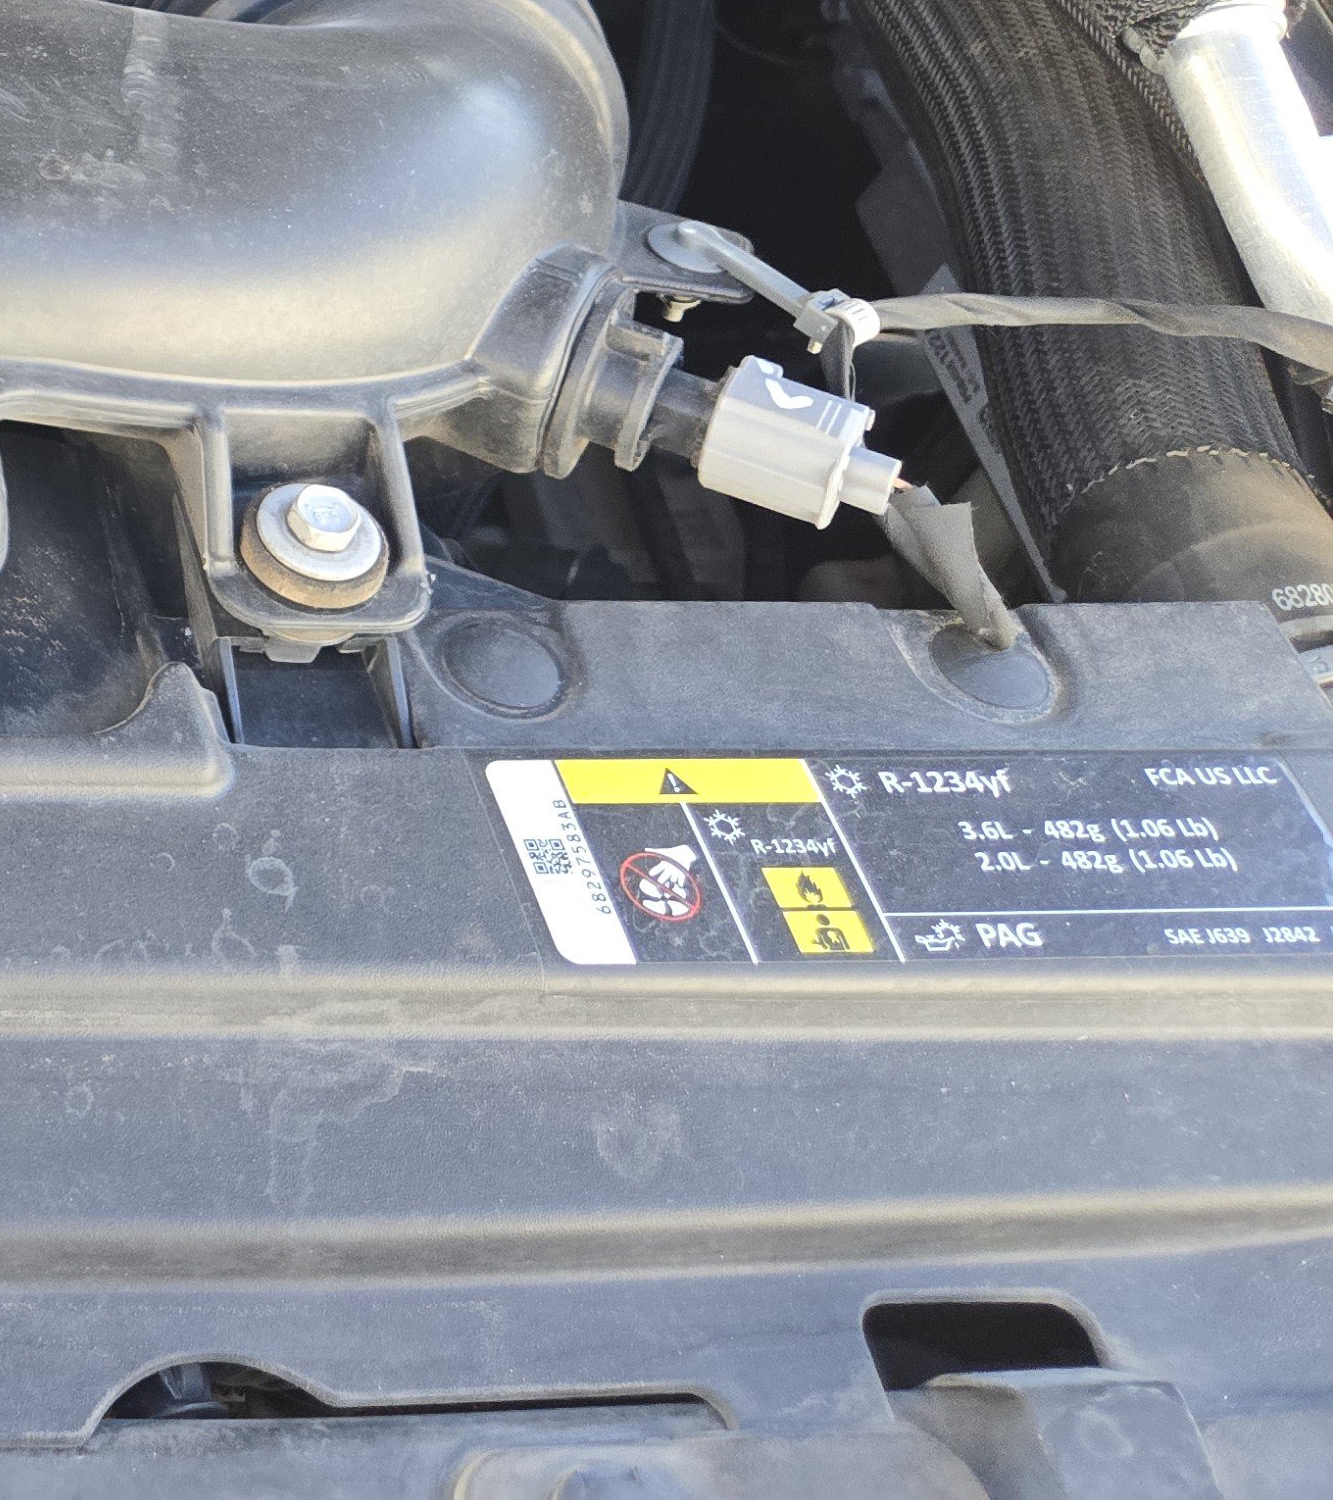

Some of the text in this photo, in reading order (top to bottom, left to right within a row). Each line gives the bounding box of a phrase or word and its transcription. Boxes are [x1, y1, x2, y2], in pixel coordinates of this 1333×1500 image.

[877, 767, 1012, 799] R-1234yf
[1144, 766, 1277, 786] FCA US LLC
[957, 820, 1014, 840] 3.6L
[1044, 819, 1106, 843] 482g
[1110, 817, 1176, 843] (1.06
[1174, 816, 1220, 842] Lb)
[552, 798, 613, 915] 68297583AB
[750, 837, 837, 858] R-1234yf
[974, 851, 1031, 871] 2.0L
[1061, 850, 1125, 874] 482g
[1128, 848, 1194, 874] (1.06
[1193, 846, 1239, 873] Lb)
[974, 921, 1044, 949] PAG
[1163, 925, 1322, 945] SAE J639 J2842
